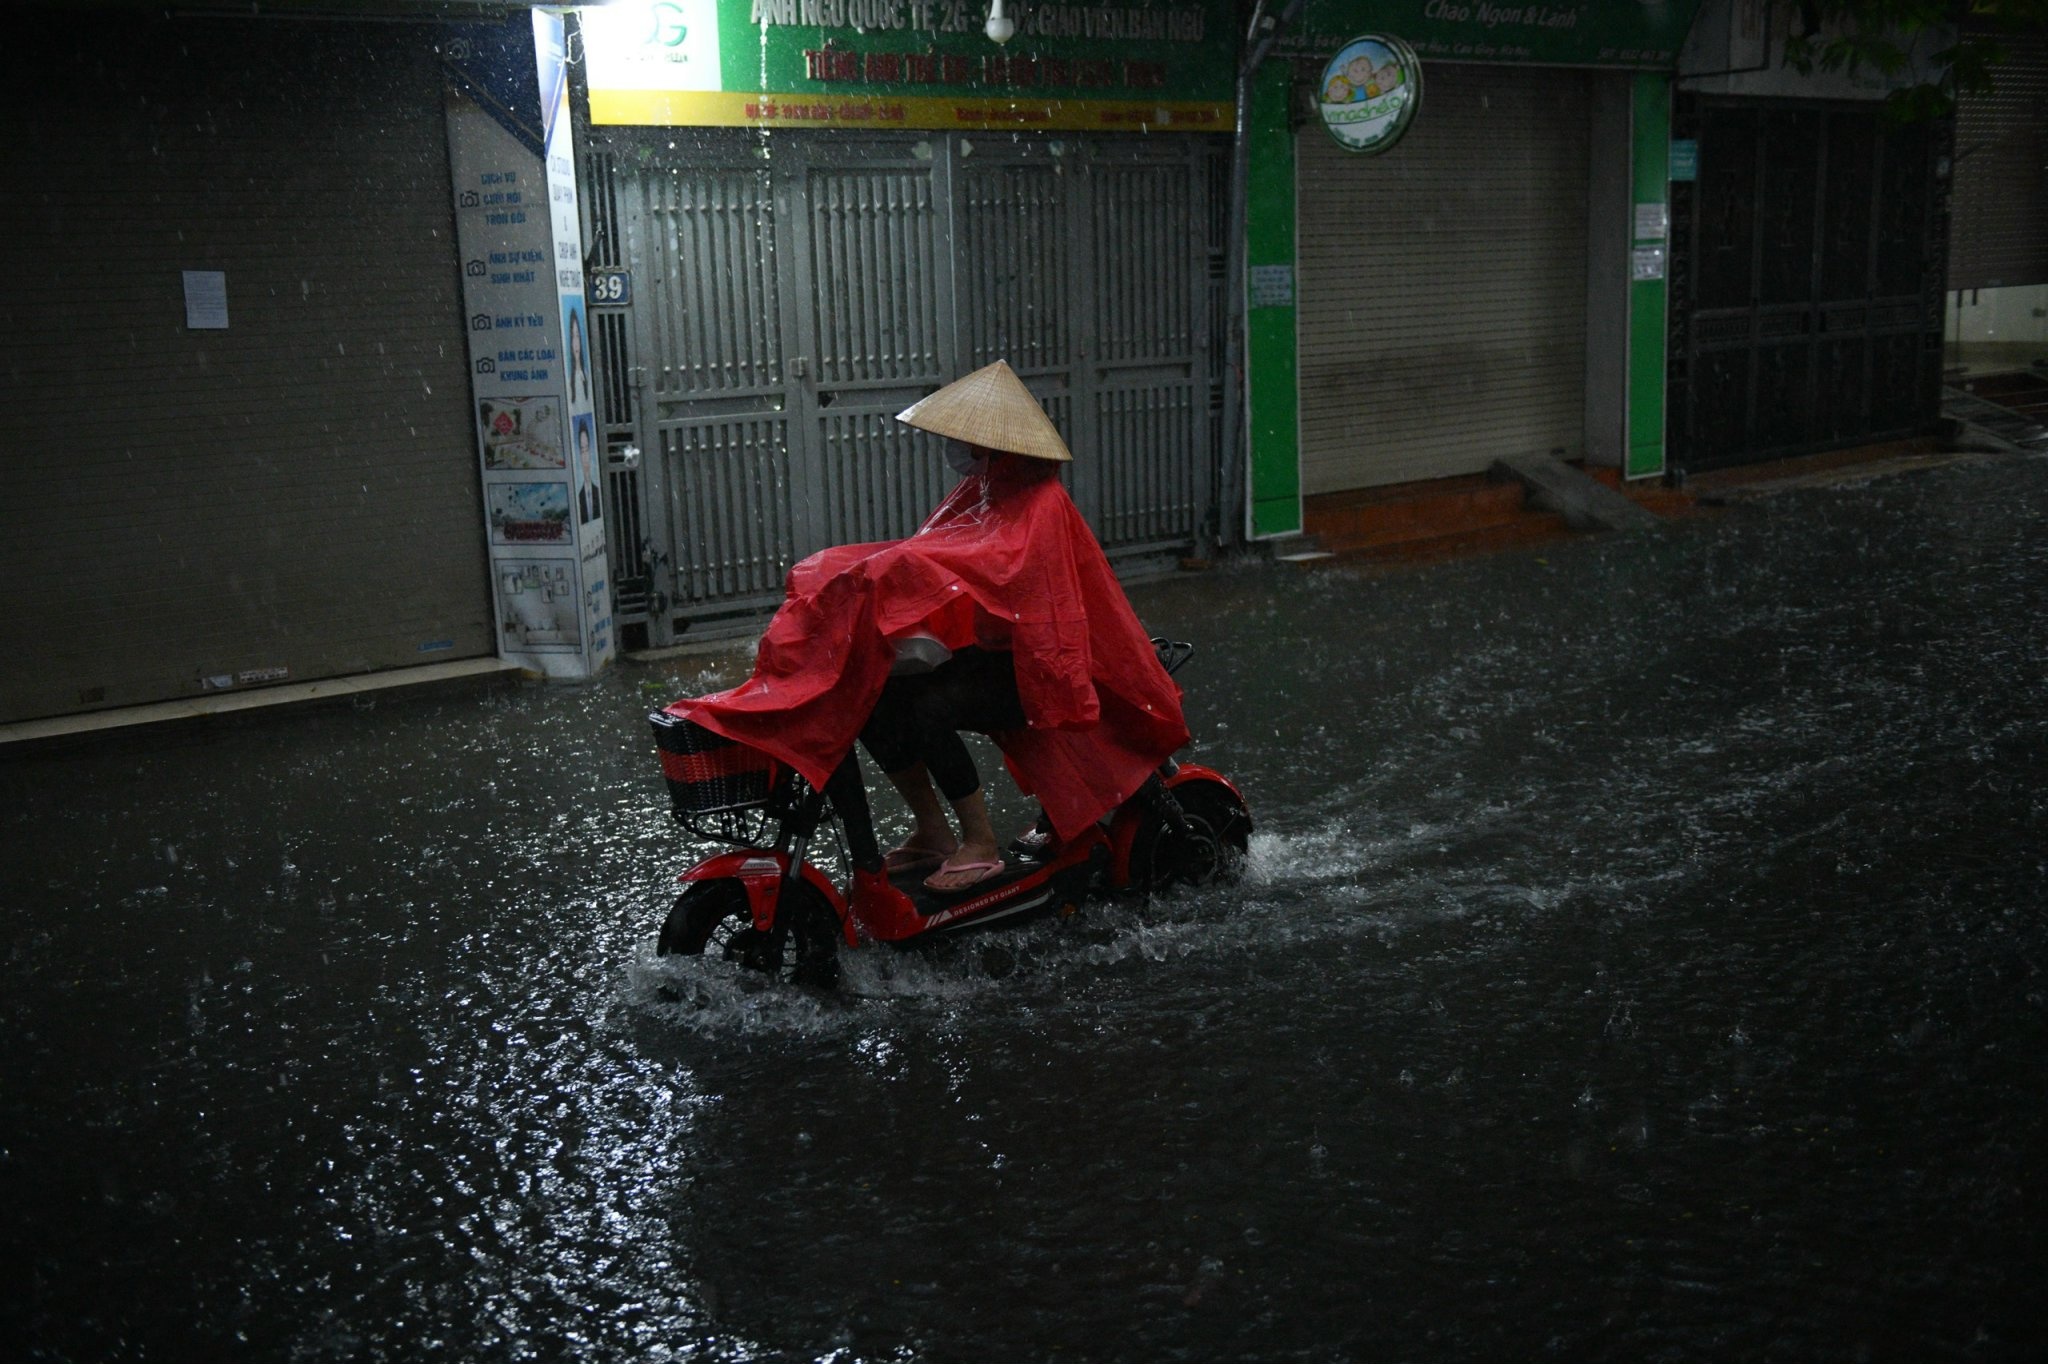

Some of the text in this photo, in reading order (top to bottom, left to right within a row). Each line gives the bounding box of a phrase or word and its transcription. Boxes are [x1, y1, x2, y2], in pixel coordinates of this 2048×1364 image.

[940, 2, 969, 32] 2G
[594, 275, 622, 300] 39
[953, 886, 1021, 916] DESIGNED BY GIANT
